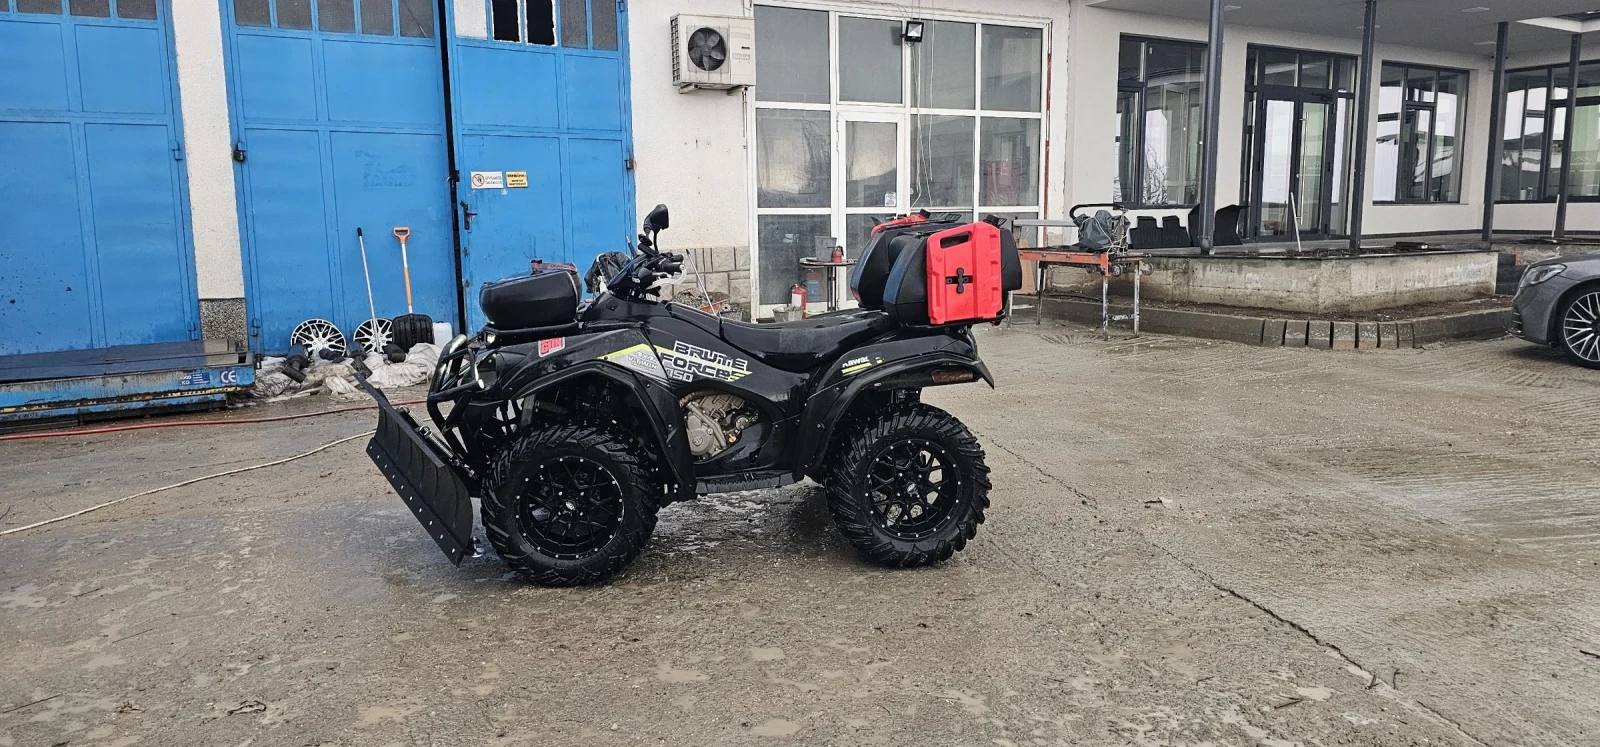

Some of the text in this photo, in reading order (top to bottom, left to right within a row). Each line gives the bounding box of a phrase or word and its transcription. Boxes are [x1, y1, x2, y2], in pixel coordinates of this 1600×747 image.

[660, 352, 736, 382] FORCE
[673, 340, 748, 371] BRUTE
[221, 371, 236, 382] CE
